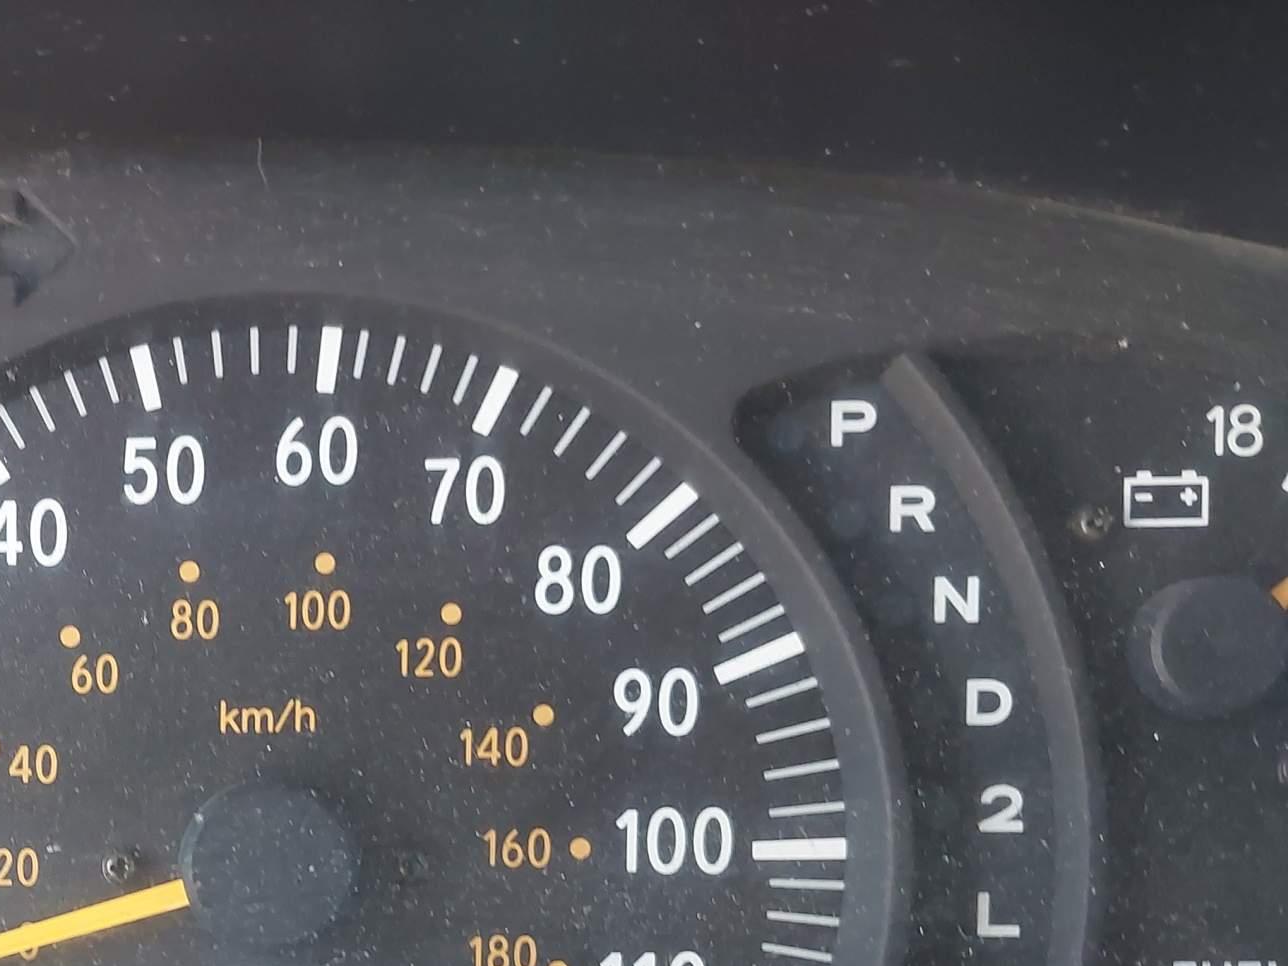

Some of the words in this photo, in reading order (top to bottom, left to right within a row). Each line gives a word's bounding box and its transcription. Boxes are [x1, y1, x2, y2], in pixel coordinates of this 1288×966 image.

[831, 400, 876, 447] P
[1207, 404, 1263, 457] 18
[123, 435, 205, 504] 50
[276, 416, 357, 486] 60
[425, 456, 504, 525] 70
[890, 485, 935, 532] R
[535, 545, 621, 614] 80
[934, 576, 979, 623] N
[170, 599, 219, 640] 80
[284, 590, 351, 630] 100
[71, 653, 118, 694] 60
[396, 638, 462, 677] 120
[220, 700, 316, 734] km/h
[614, 668, 699, 737] 90
[966, 679, 1012, 726] D
[9, 744, 58, 785] 40
[460, 727, 528, 767] 140
[978, 784, 1024, 833] 2
[483, 828, 551, 868] 160
[615, 806, 732, 875] 100
[977, 892, 1020, 938] L
